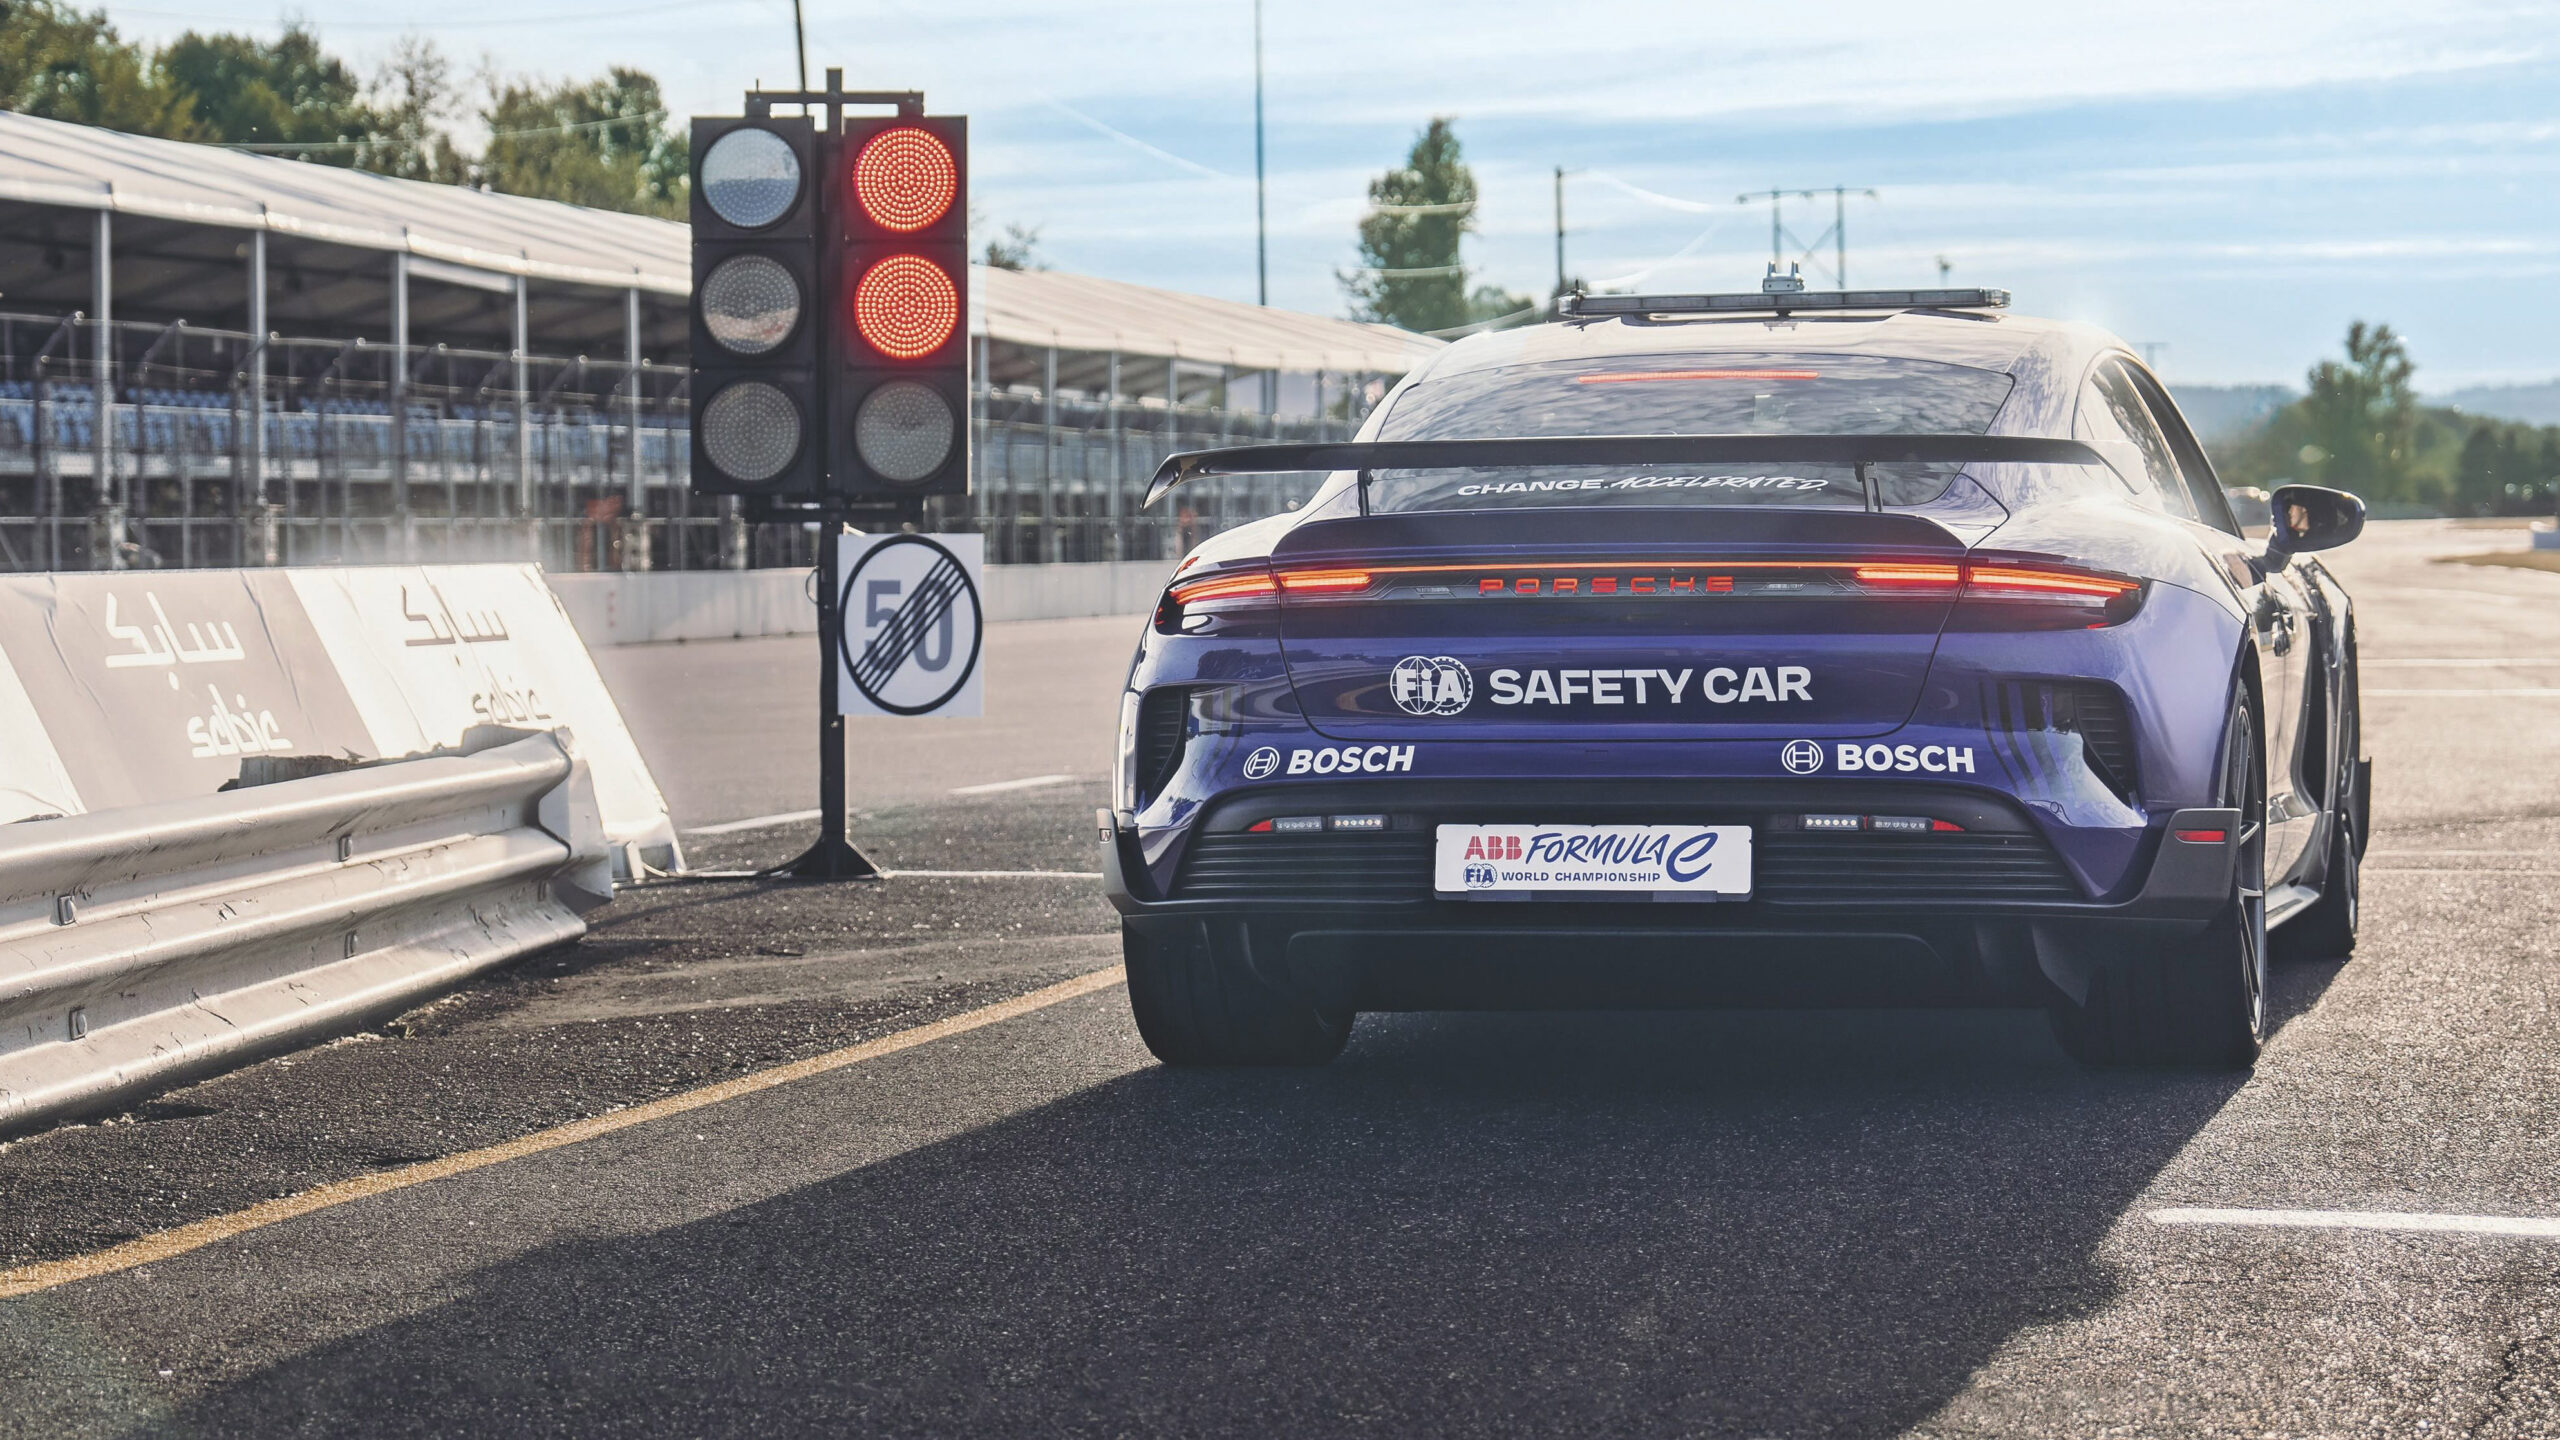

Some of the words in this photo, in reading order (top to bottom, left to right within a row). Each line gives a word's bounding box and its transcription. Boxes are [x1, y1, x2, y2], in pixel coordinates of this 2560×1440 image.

[1478, 576, 1734, 594] PORSCHE
[864, 578, 953, 673] 50
[471, 664, 551, 725] sabic
[1489, 668, 1693, 705] SAFETY
[1702, 666, 1813, 703] CAR
[187, 683, 293, 758] sabic
[1286, 745, 1415, 774] BOSCH
[1837, 743, 1975, 773] BOSCH
[1463, 835, 1523, 861] ABB
[1525, 832, 1671, 865] FORMULA
[1501, 871, 1549, 882] WORLD
[1554, 871, 1661, 883] CHAMPIONSHIP
